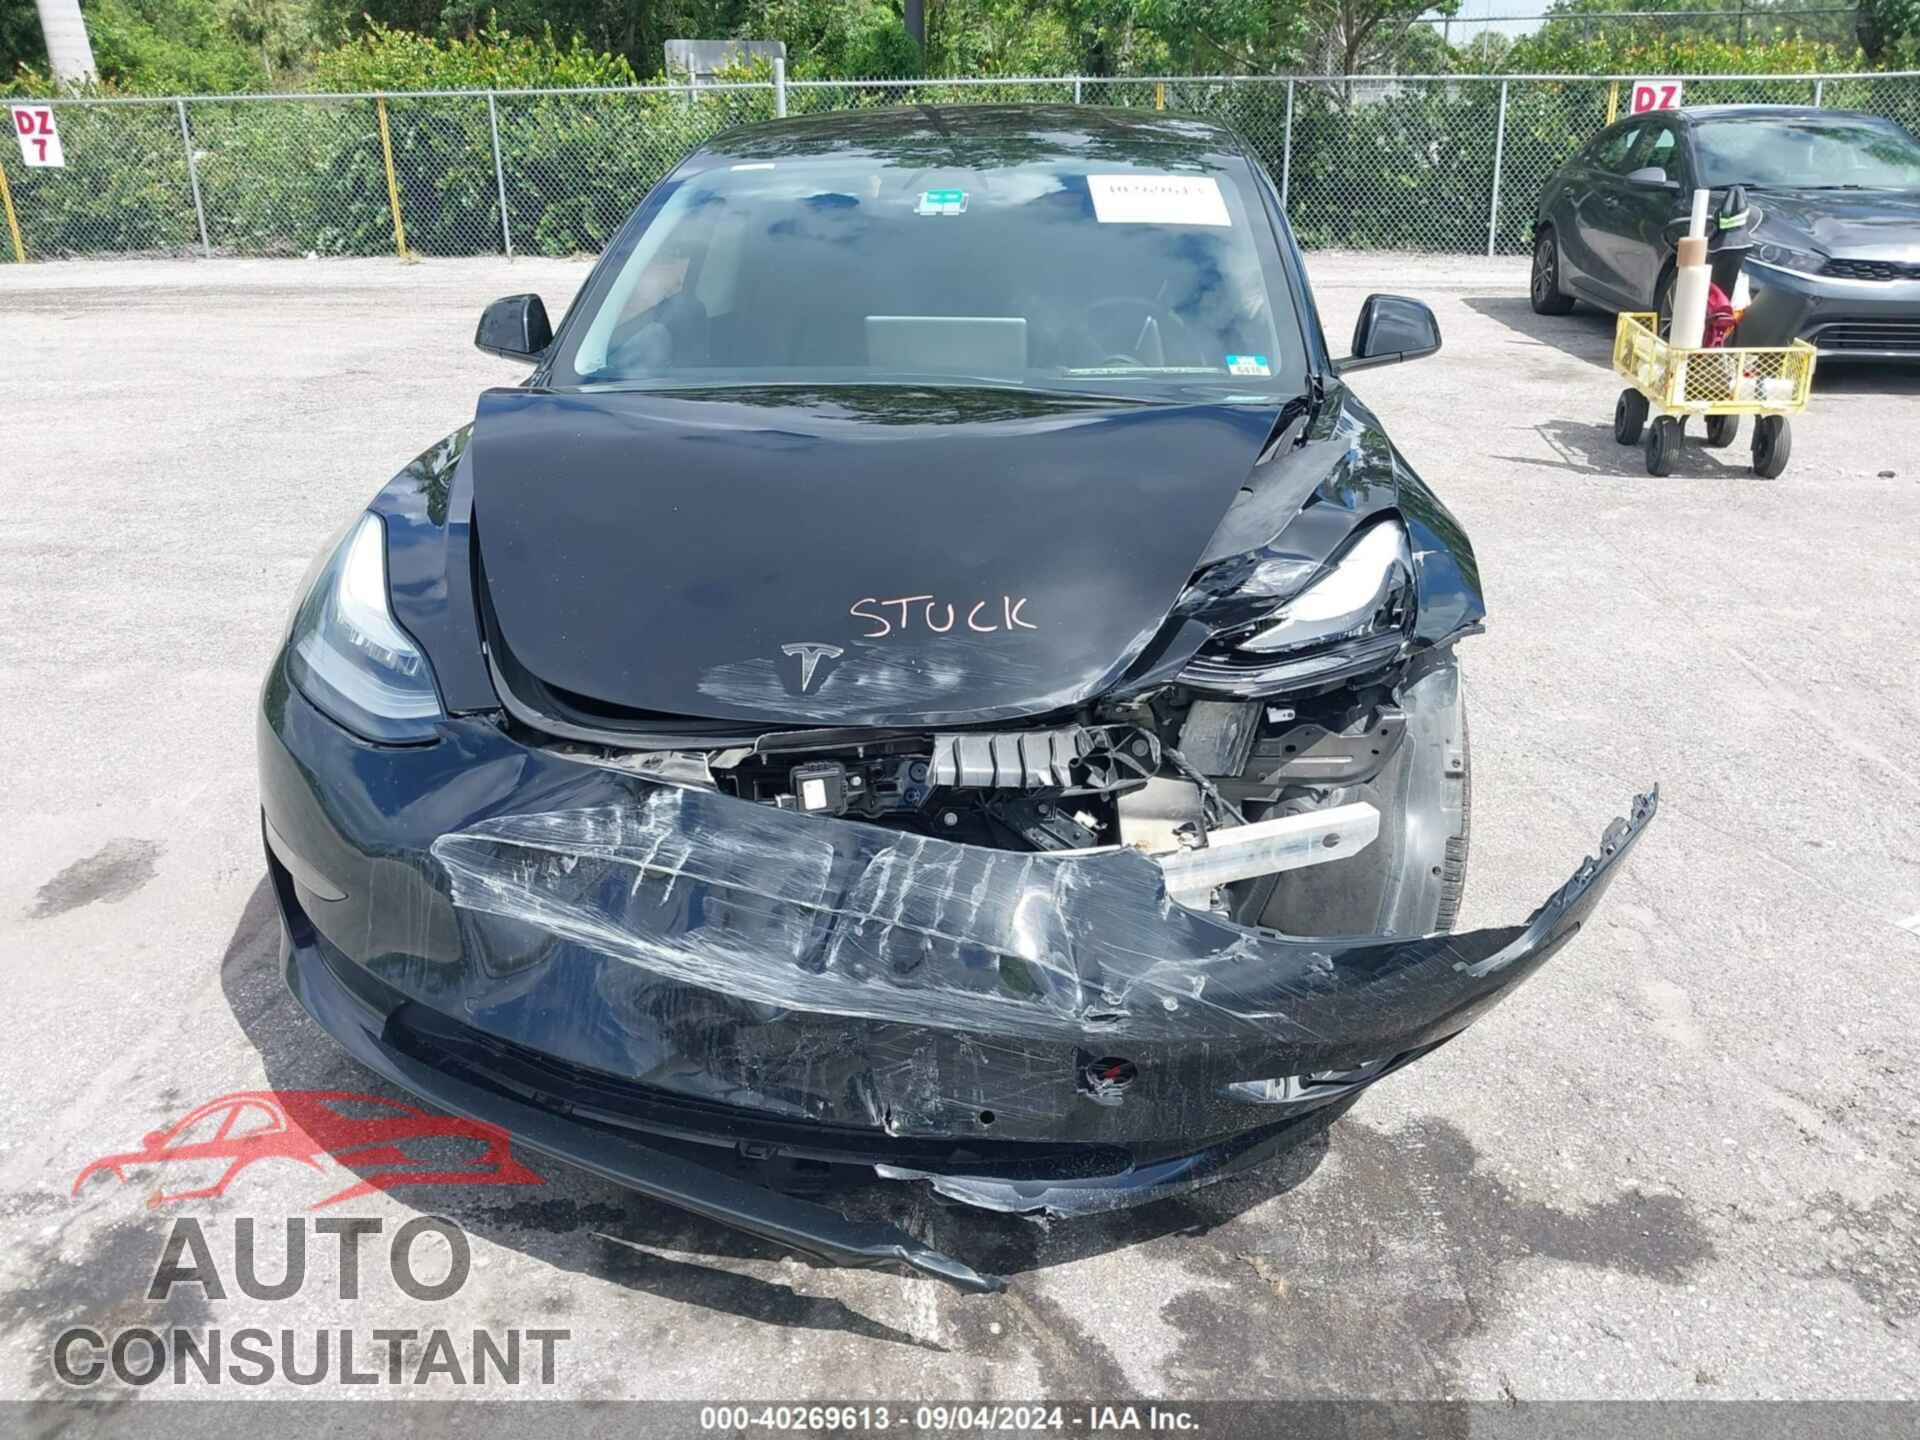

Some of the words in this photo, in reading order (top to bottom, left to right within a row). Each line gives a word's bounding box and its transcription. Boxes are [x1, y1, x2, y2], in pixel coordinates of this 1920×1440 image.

[1634, 86, 1677, 113] DZ
[15, 110, 54, 135] DZ
[32, 139, 47, 161] 7
[850, 595, 1038, 637] STUCK
